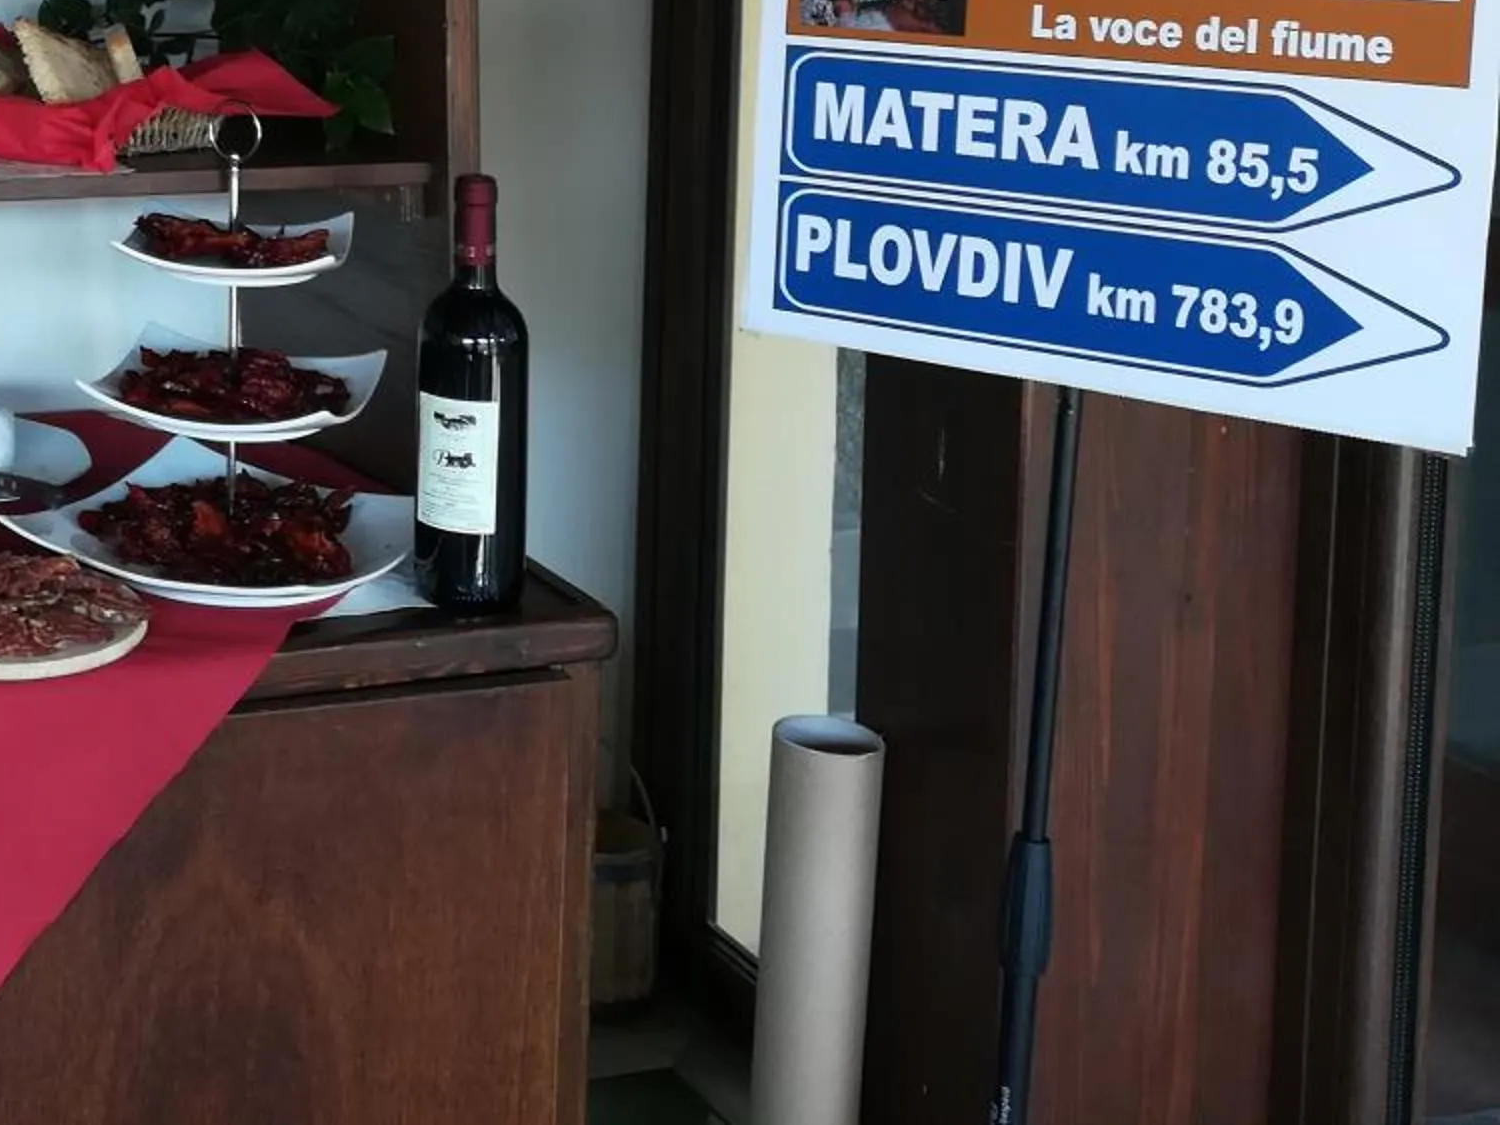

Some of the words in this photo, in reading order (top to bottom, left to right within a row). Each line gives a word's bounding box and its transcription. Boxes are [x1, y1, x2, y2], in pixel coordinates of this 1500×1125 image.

[1031, 4, 1077, 42] La
[1090, 16, 1180, 50] voce
[1195, 16, 1257, 55] del
[1270, 19, 1393, 65] fiume
[812, 81, 1098, 170] MATERA
[1114, 130, 1190, 180] km
[1206, 139, 1319, 200] 85,5
[794, 214, 1074, 309] PLOVDIV
[1086, 273, 1156, 324] km
[1171, 285, 1305, 350] 783,9
